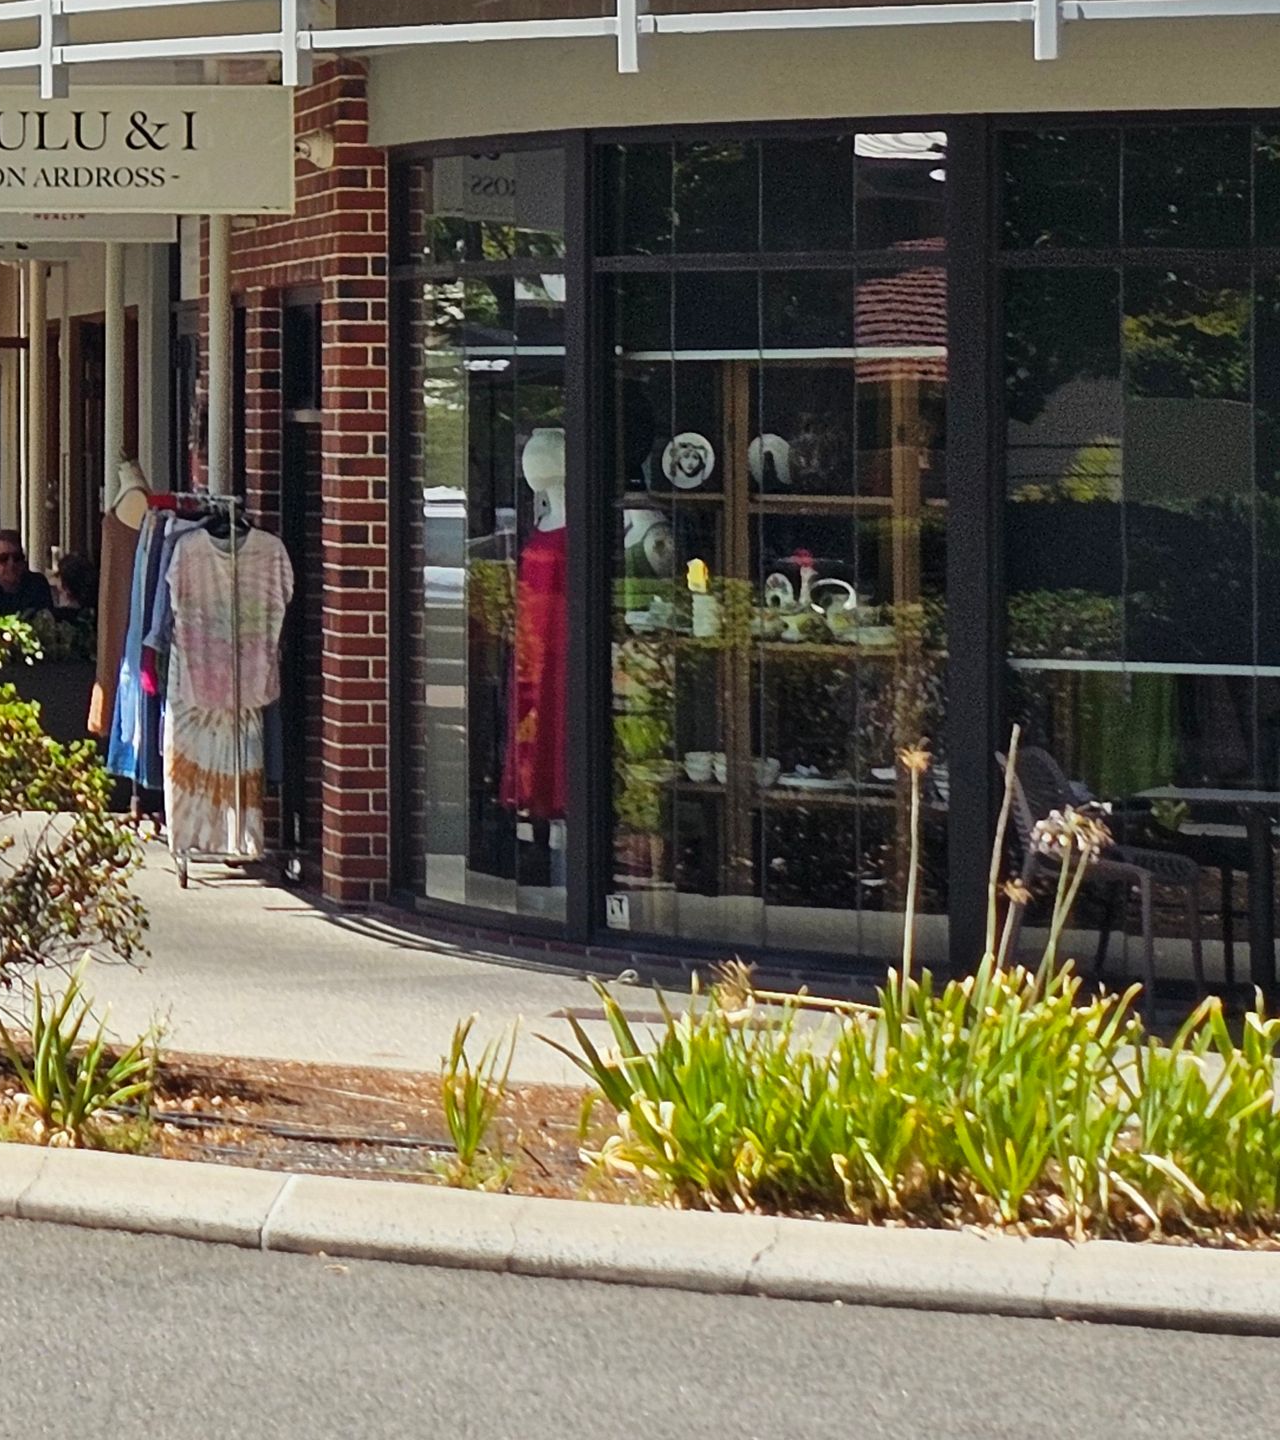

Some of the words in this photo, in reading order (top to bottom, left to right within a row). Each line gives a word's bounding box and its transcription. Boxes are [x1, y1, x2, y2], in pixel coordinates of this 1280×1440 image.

[125, 110, 170, 151] &
[182, 111, 198, 151] I
[33, 166, 166, 188] ARDROSS
